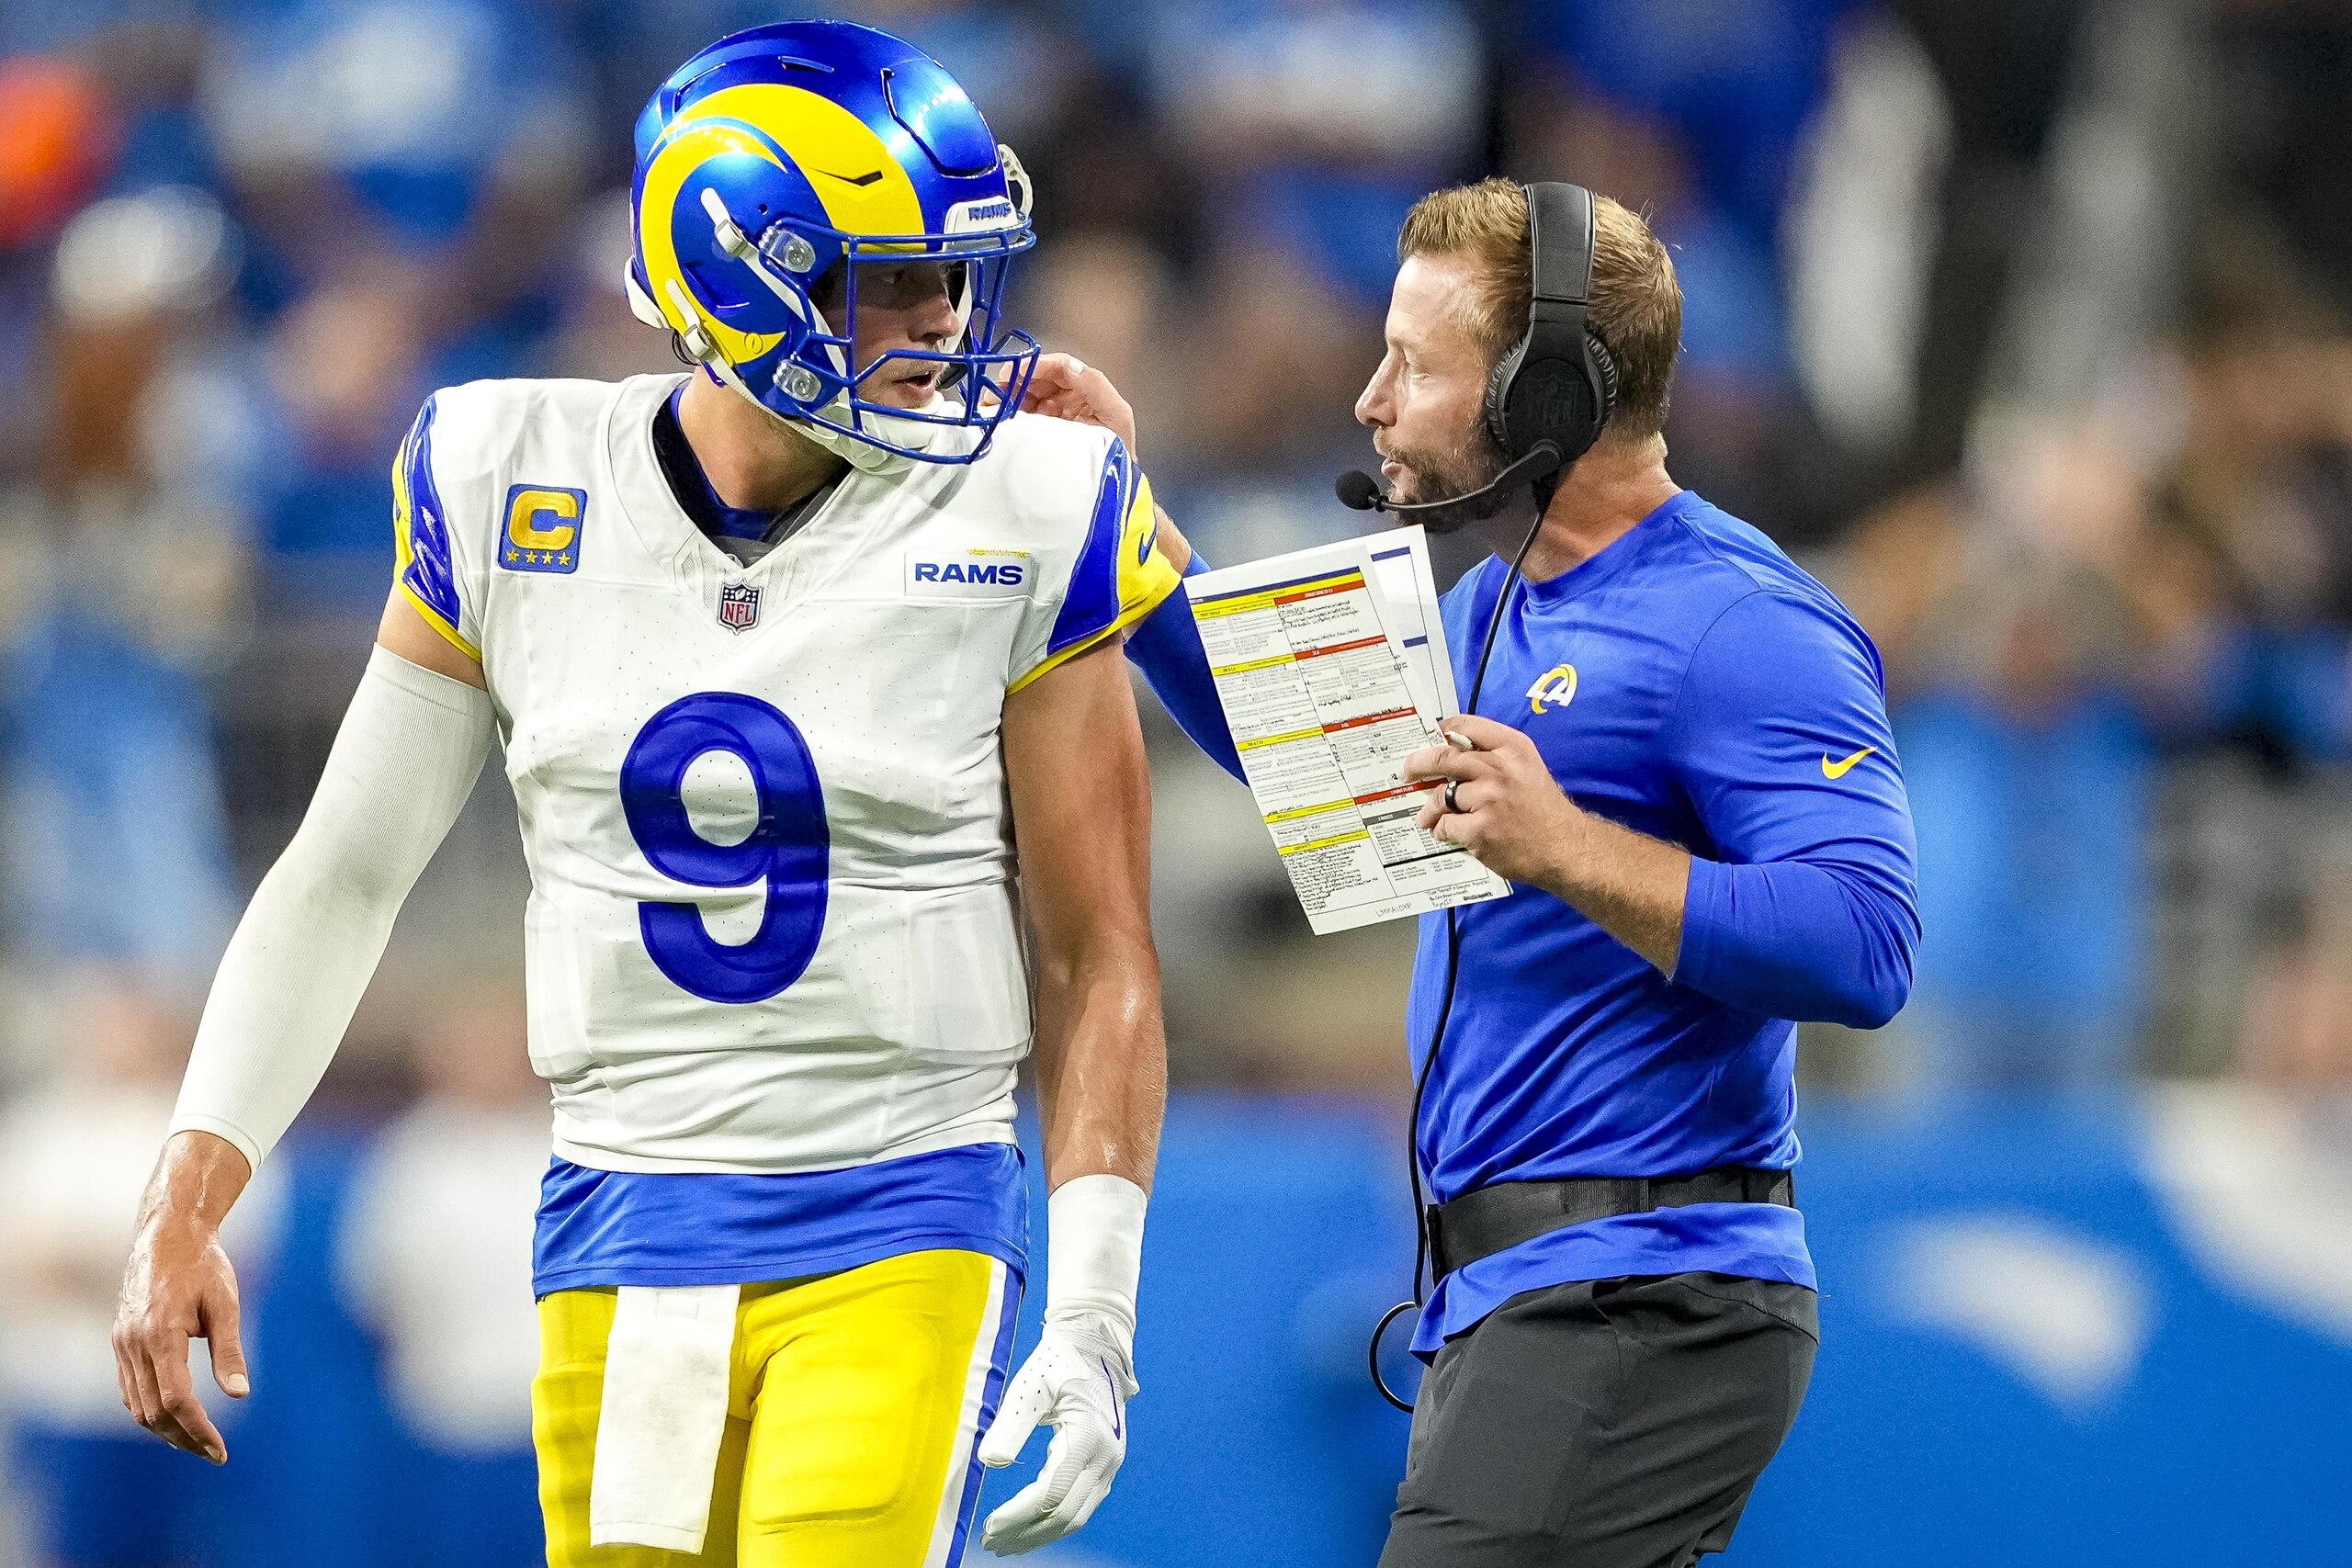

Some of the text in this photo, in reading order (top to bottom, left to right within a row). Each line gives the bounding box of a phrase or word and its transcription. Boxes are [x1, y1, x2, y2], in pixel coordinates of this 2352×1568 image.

[968, 202, 1012, 220] RAMS
[508, 490, 577, 551] C
[915, 563, 1023, 586] RAMS
[724, 603, 752, 625] NFL
[619, 691, 831, 1004] 9
